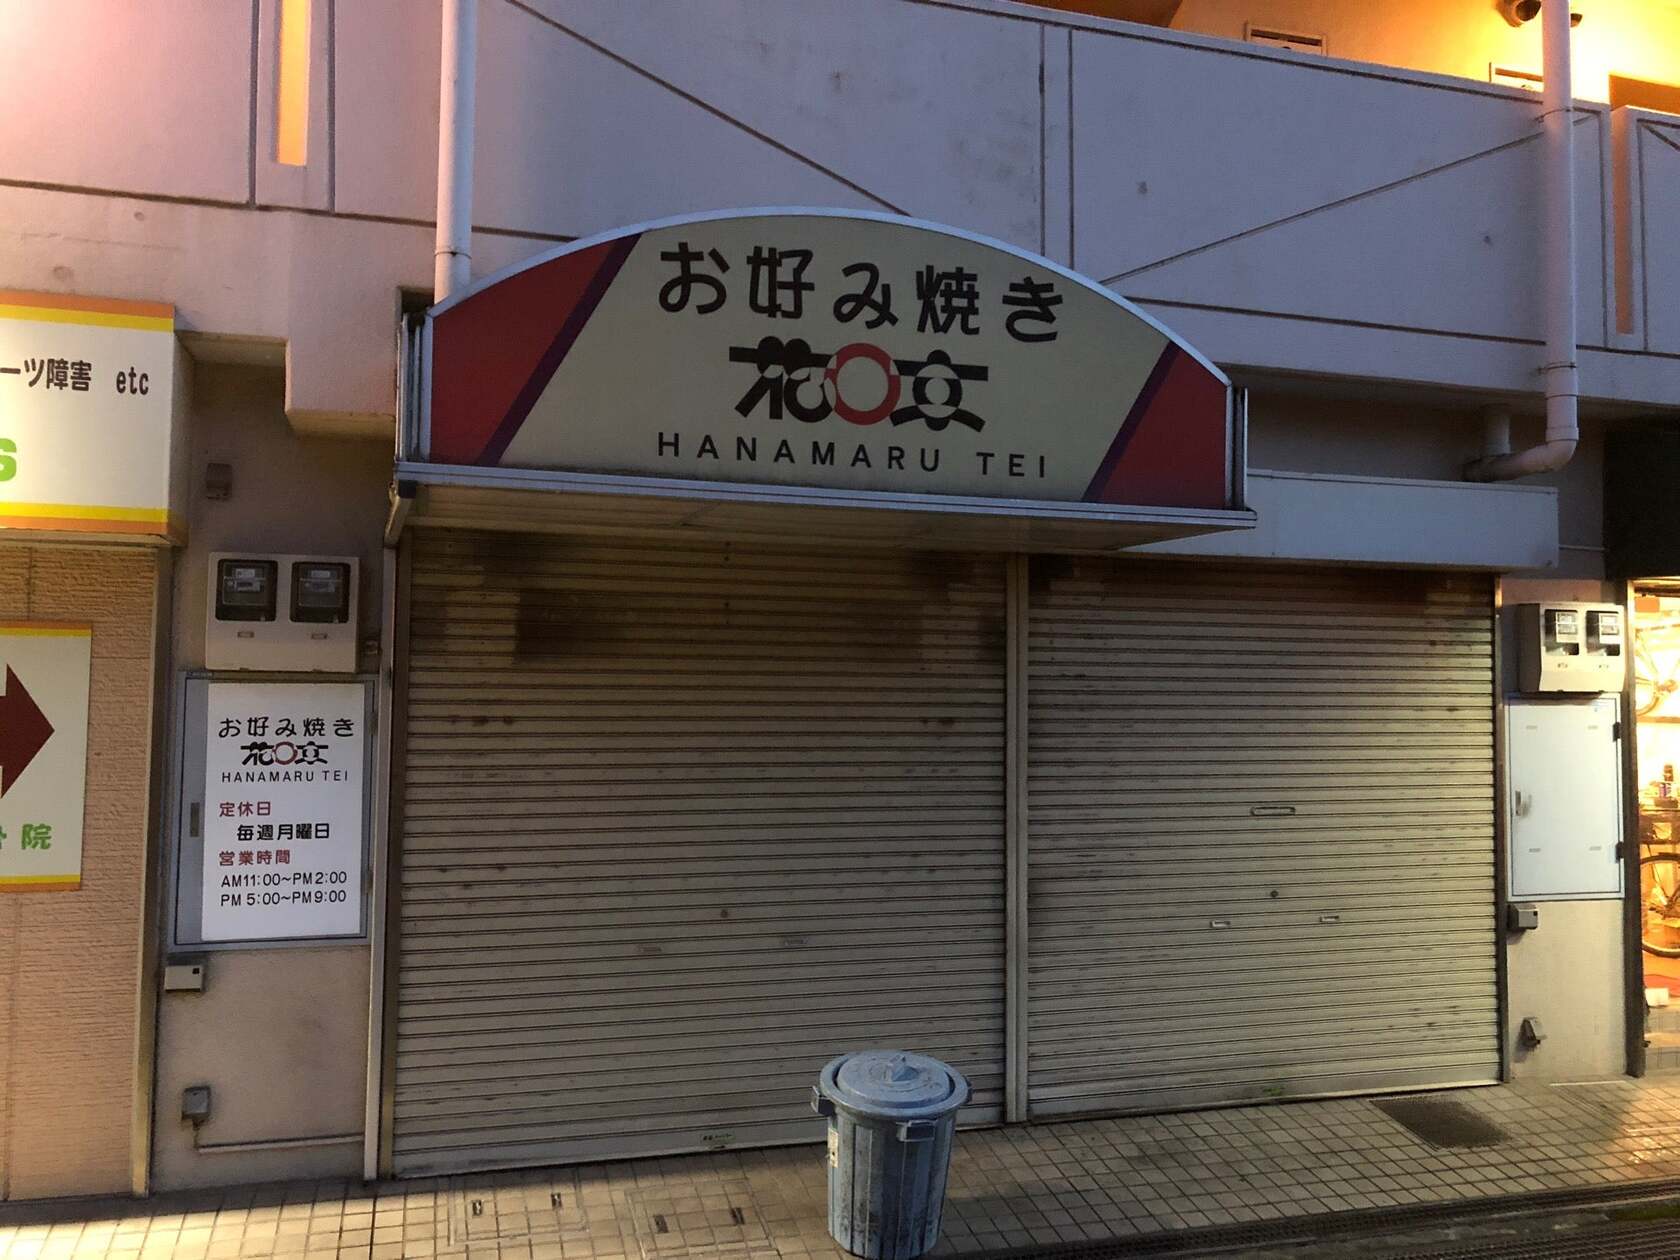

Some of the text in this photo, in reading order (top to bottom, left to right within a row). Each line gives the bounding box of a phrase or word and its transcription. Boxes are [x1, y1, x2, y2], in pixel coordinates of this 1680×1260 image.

[658, 242, 1063, 343] お好み焼き
[116, 366, 149, 395] etc
[657, 432, 1045, 478] HANAMARU TEI
[218, 717, 354, 738] お好み焼き
[222, 770, 348, 783] HANAMARU TEI
[219, 801, 271, 817] 定休日
[0, 823, 52, 850] 院
[237, 823, 330, 841] 毎週月曜日
[219, 850, 291, 866] 営業時間
